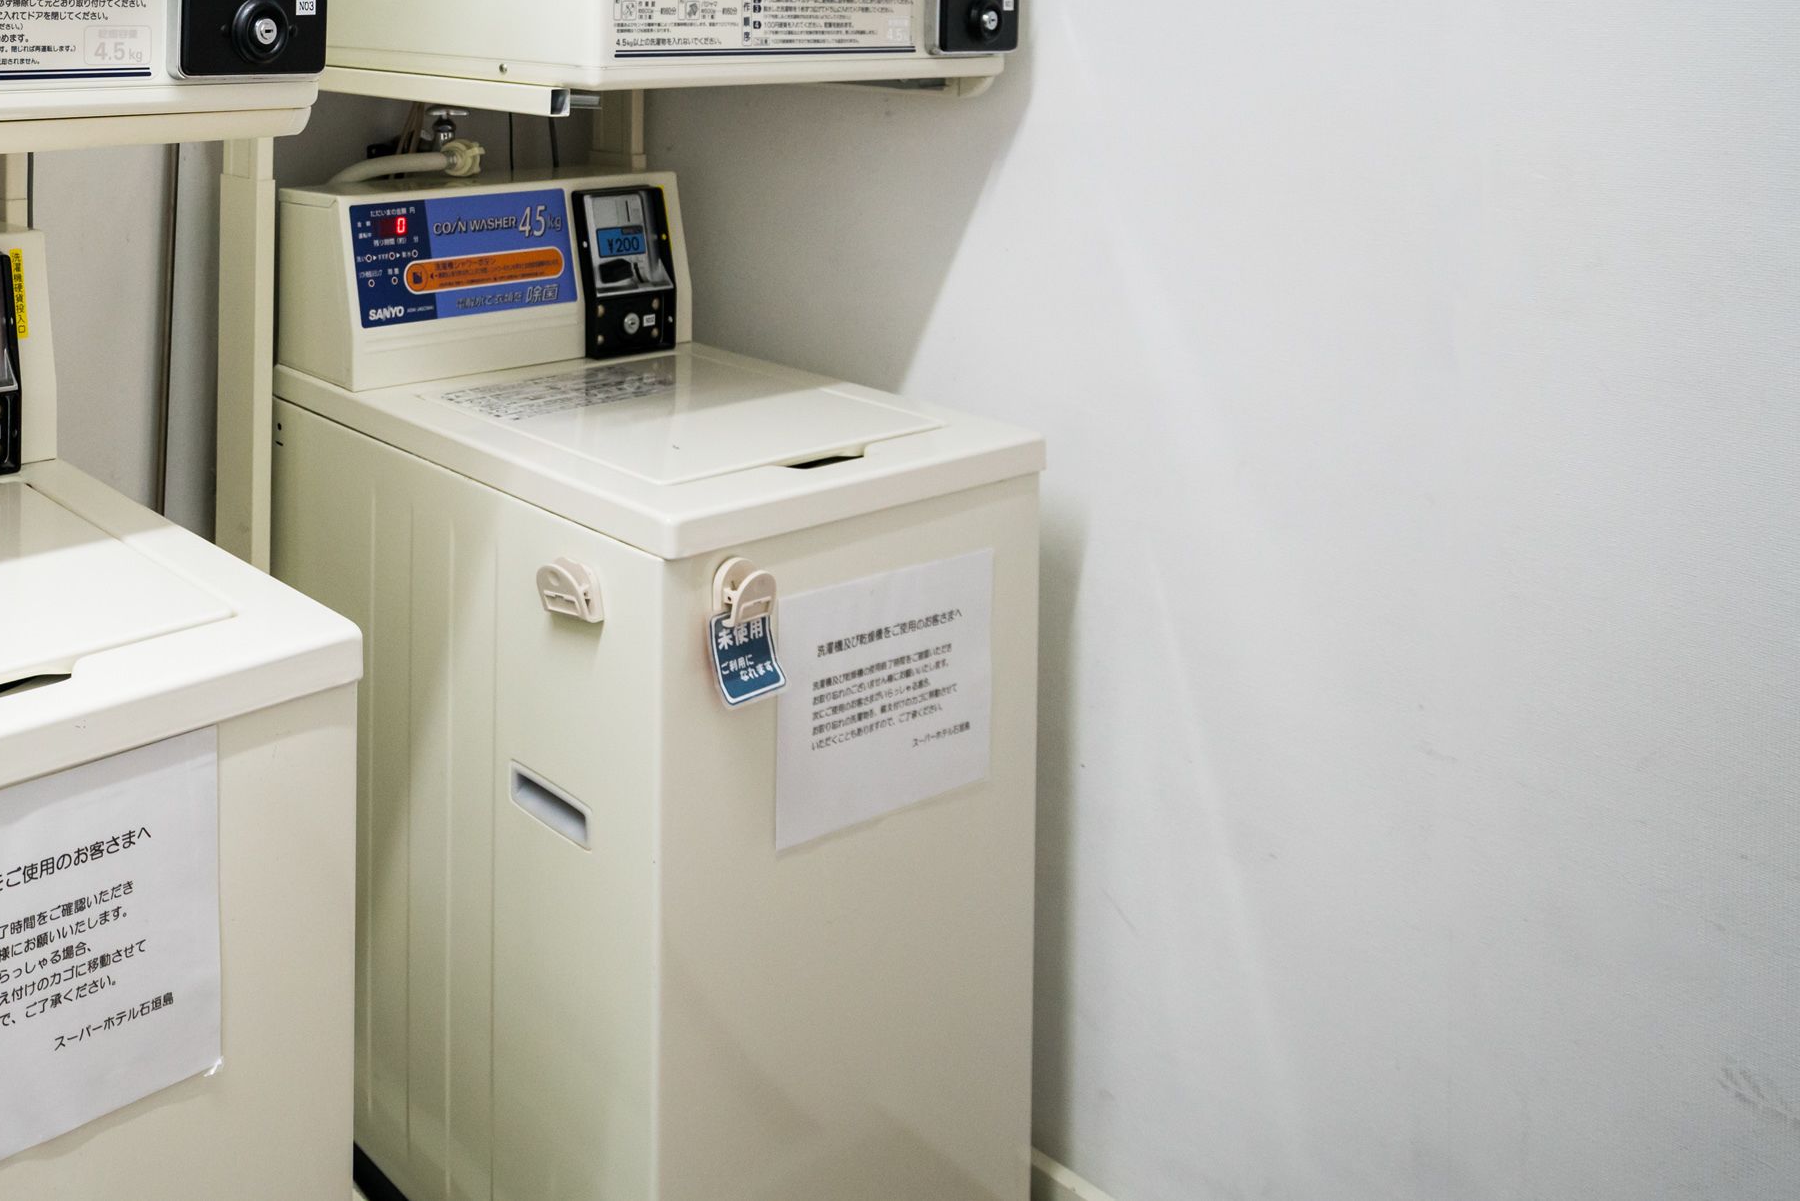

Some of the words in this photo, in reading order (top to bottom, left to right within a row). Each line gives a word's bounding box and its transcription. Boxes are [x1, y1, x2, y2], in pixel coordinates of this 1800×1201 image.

[397, 217, 406, 234] 0
[470, 216, 517, 232] WASHER
[518, 205, 547, 238] 4.5
[549, 213, 562, 232] kg
[607, 236, 640, 254] ¥200
[11, 252, 27, 335] 洗濯機硬貨投入口
[368, 305, 405, 321] SANYO
[717, 619, 763, 650] 未使用
[721, 654, 754, 675] ご利用に
[740, 660, 774, 681] なれます
[54, 991, 174, 1051] スーパーホテル石垣島
